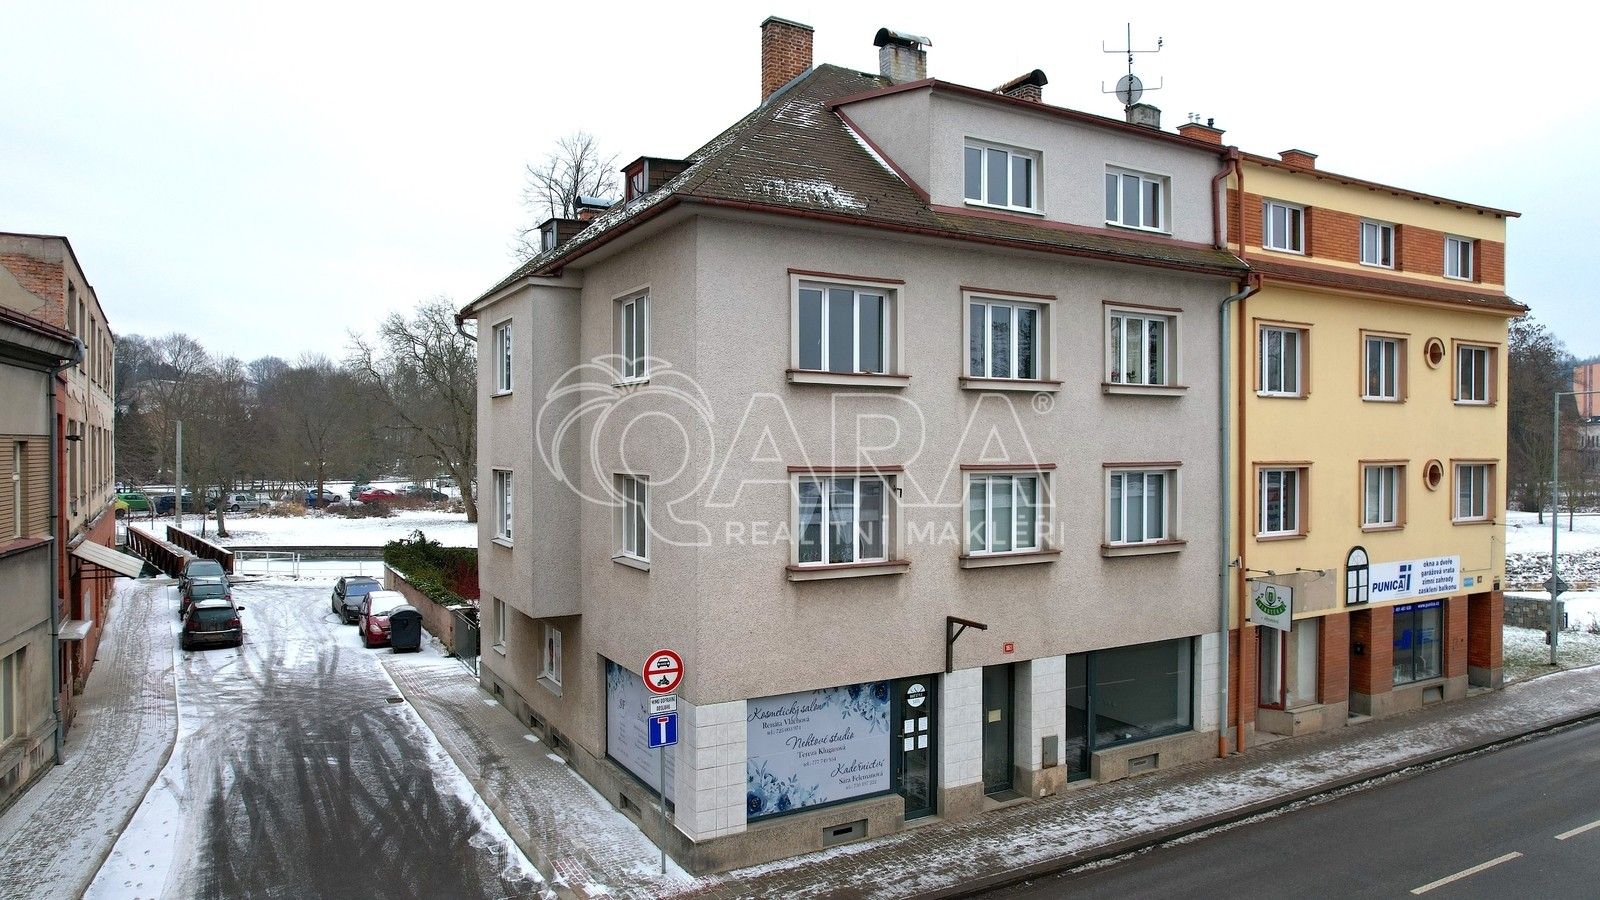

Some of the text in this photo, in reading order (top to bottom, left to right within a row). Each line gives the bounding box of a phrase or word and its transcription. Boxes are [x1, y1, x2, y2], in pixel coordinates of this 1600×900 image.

[1372, 580, 1404, 593] PUNICA
[1435, 576, 1454, 584] zahrady
[747, 698, 824, 722] Kosmetický salon
[785, 727, 855, 749] Nehtové studio
[831, 759, 885, 777] Kadeřnictví
